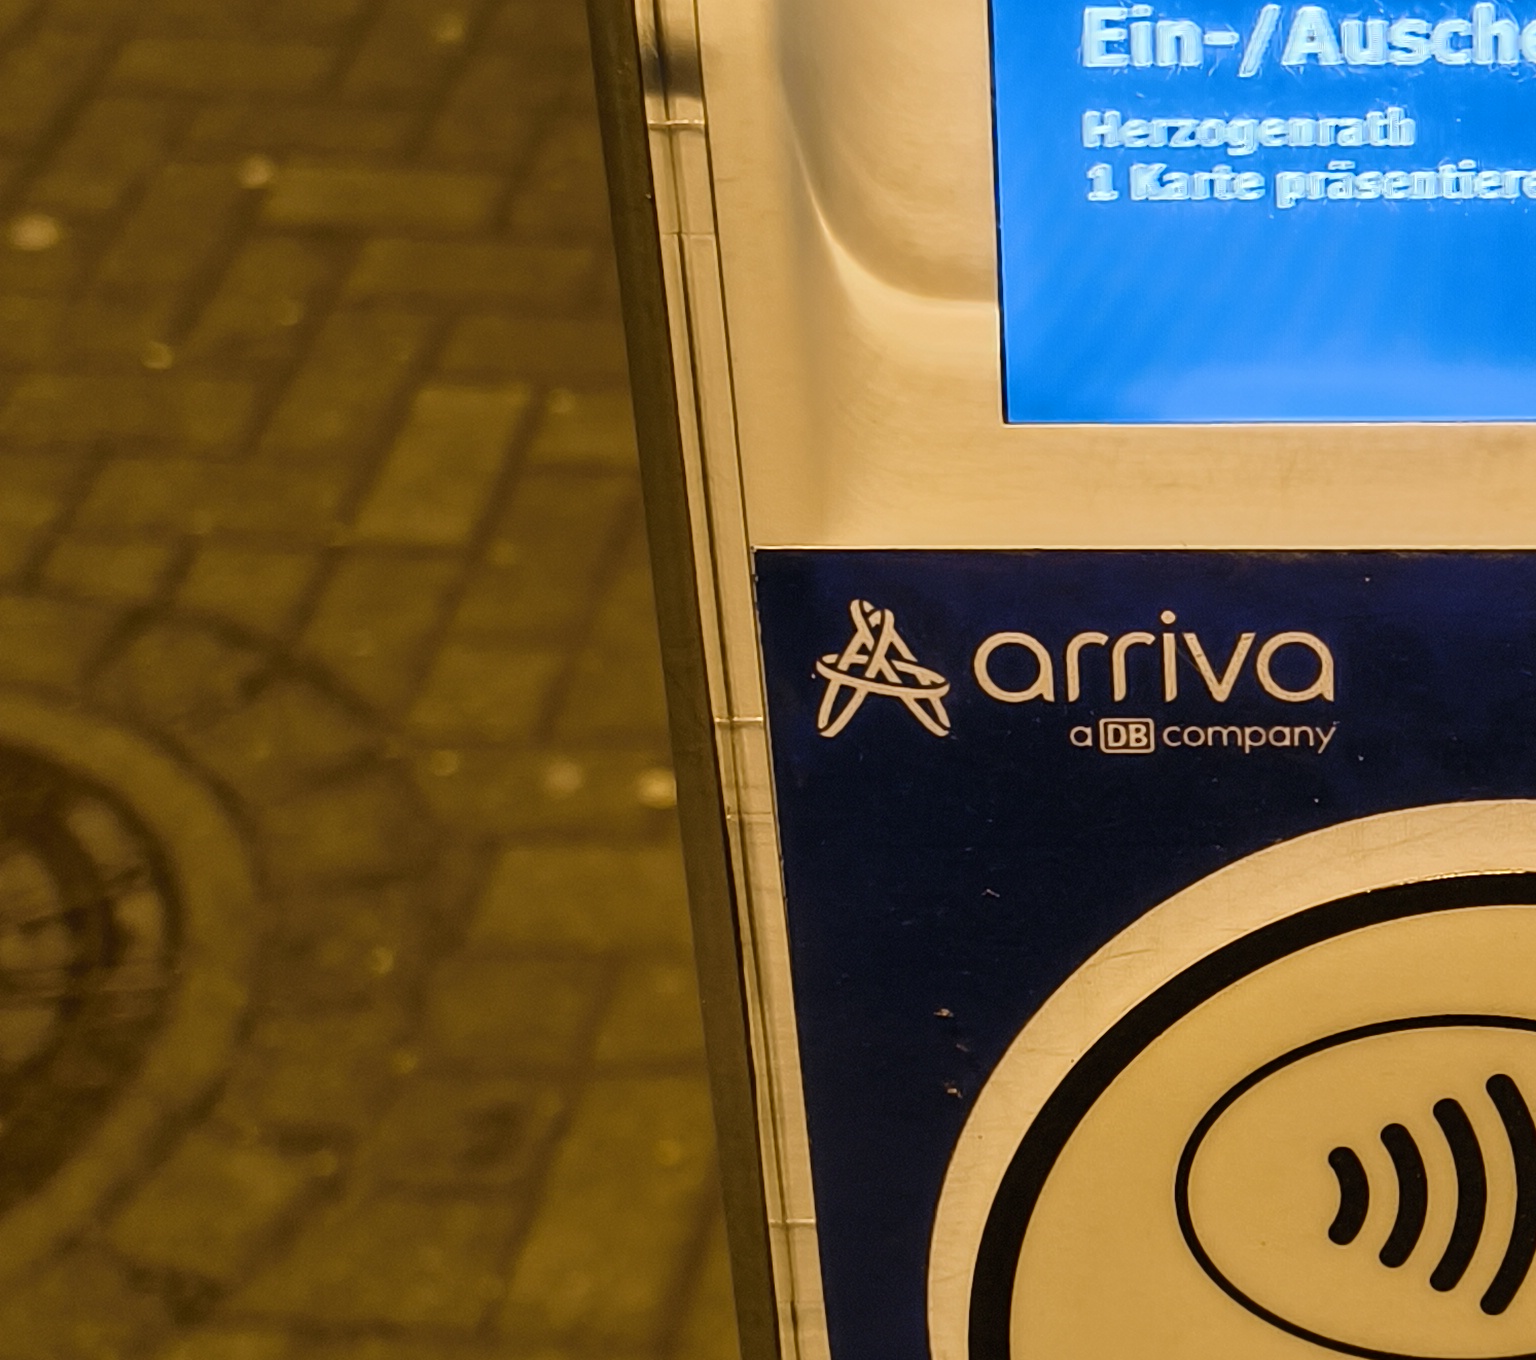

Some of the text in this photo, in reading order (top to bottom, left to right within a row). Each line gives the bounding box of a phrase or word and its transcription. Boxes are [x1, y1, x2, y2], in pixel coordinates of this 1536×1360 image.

[1082, 107, 1416, 156] Herzogenrath
[1087, 163, 1119, 201] 1
[1130, 163, 1266, 201] Karte
[973, 610, 1335, 703] arriva
[1069, 721, 1337, 754] a DB company
